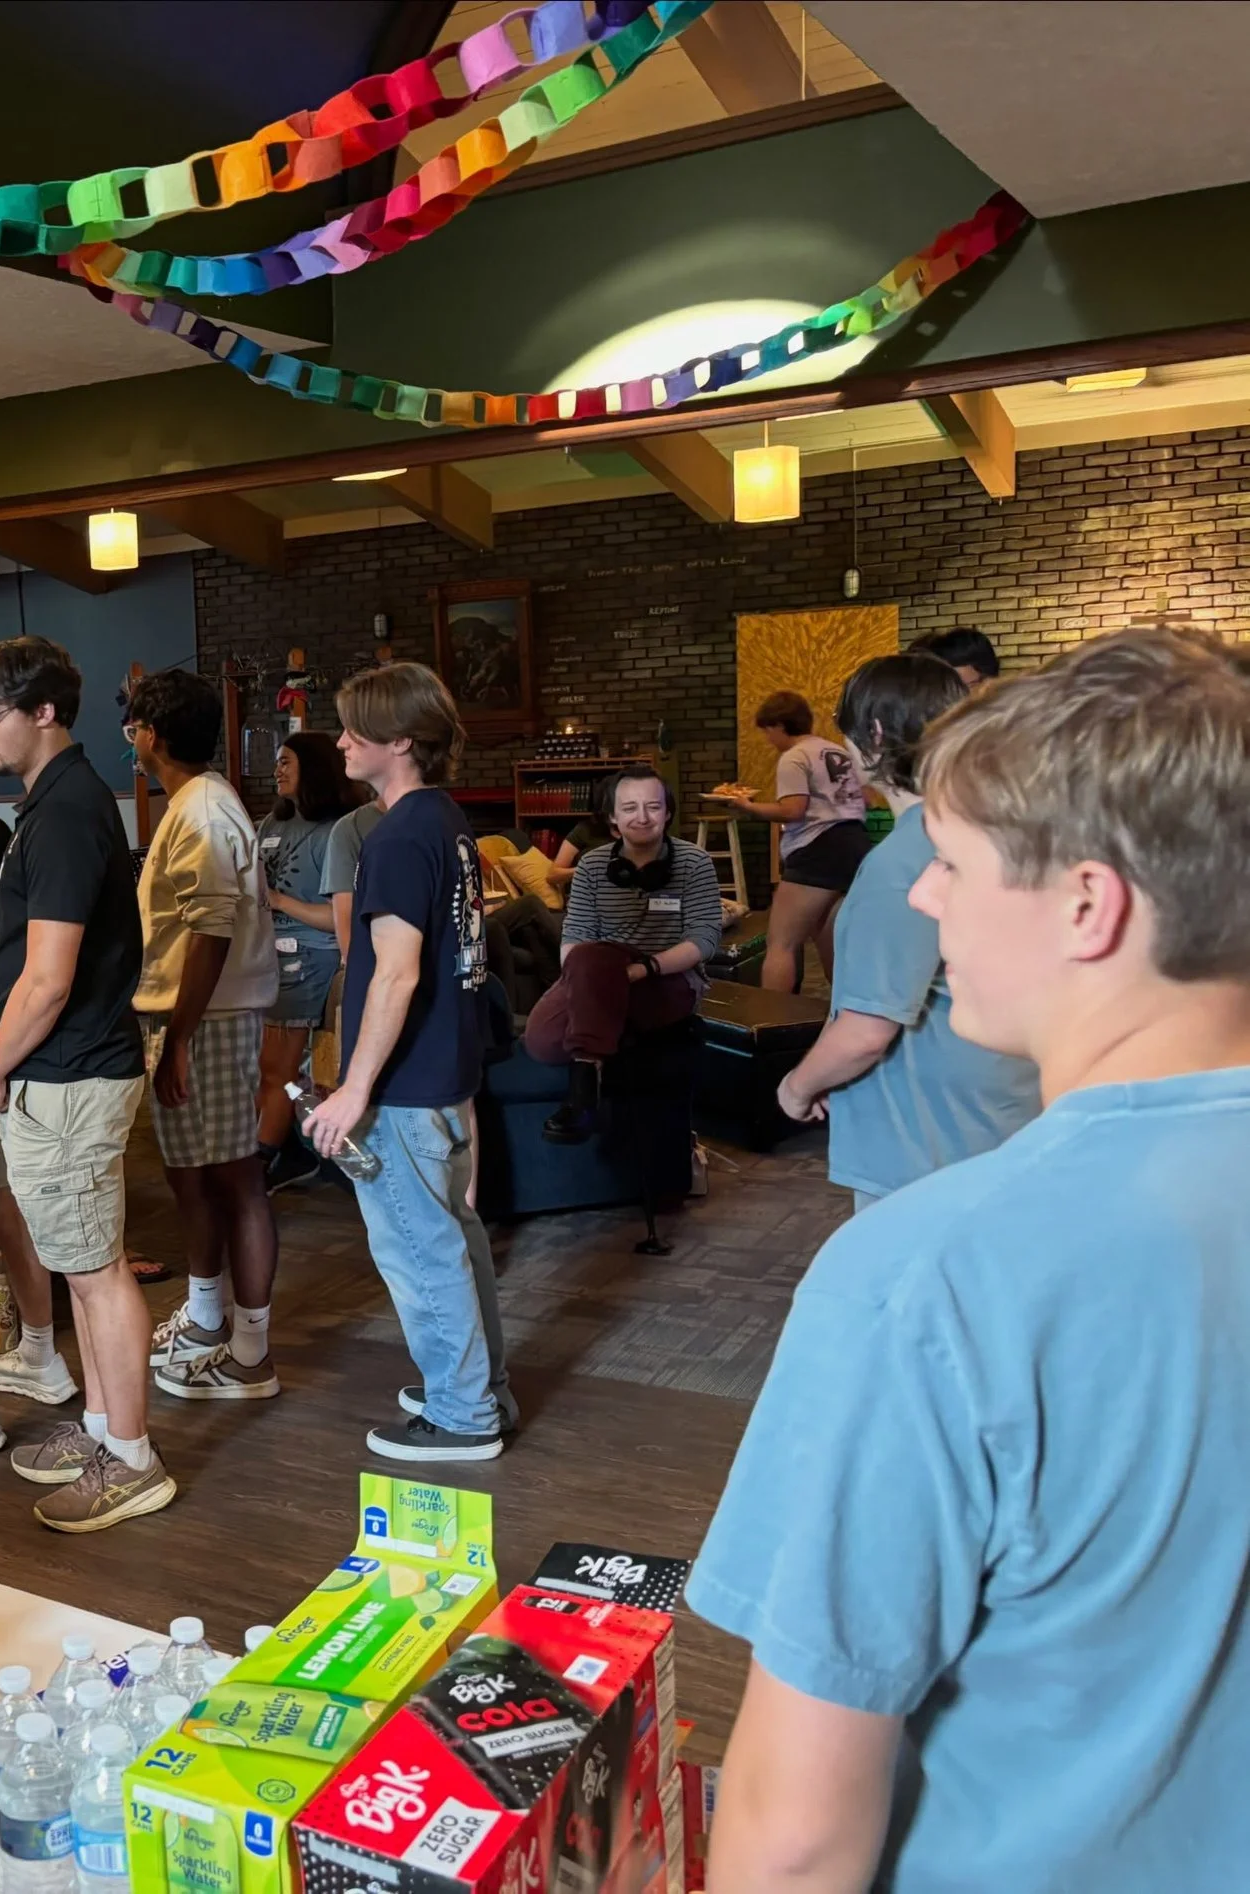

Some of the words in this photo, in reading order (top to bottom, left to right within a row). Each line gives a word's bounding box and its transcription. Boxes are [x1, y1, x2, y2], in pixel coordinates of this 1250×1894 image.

[399, 1493, 451, 1516] Sparkling
[408, 1486, 442, 1502] Water
[466, 1550, 488, 1567] 12
[276, 1616, 318, 1644] Kroger
[295, 1630, 357, 1681] LEMON
[343, 1600, 387, 1634] LIME
[251, 1691, 296, 1743] Sparkling
[274, 1702, 304, 1738] Water
[456, 1698, 559, 1732] cola
[486, 1735, 523, 1750] ZERO
[524, 1723, 575, 1741] SUGAR
[145, 1747, 184, 1770] 12
[171, 1752, 198, 1776] CANS
[131, 1802, 152, 1823] 12
[184, 1827, 215, 1851] Kroger
[419, 1814, 459, 1853] ZERO
[438, 1815, 486, 1865] SUGAR
[172, 1850, 232, 1884] Sparkling
[183, 1867, 223, 1890] Water
